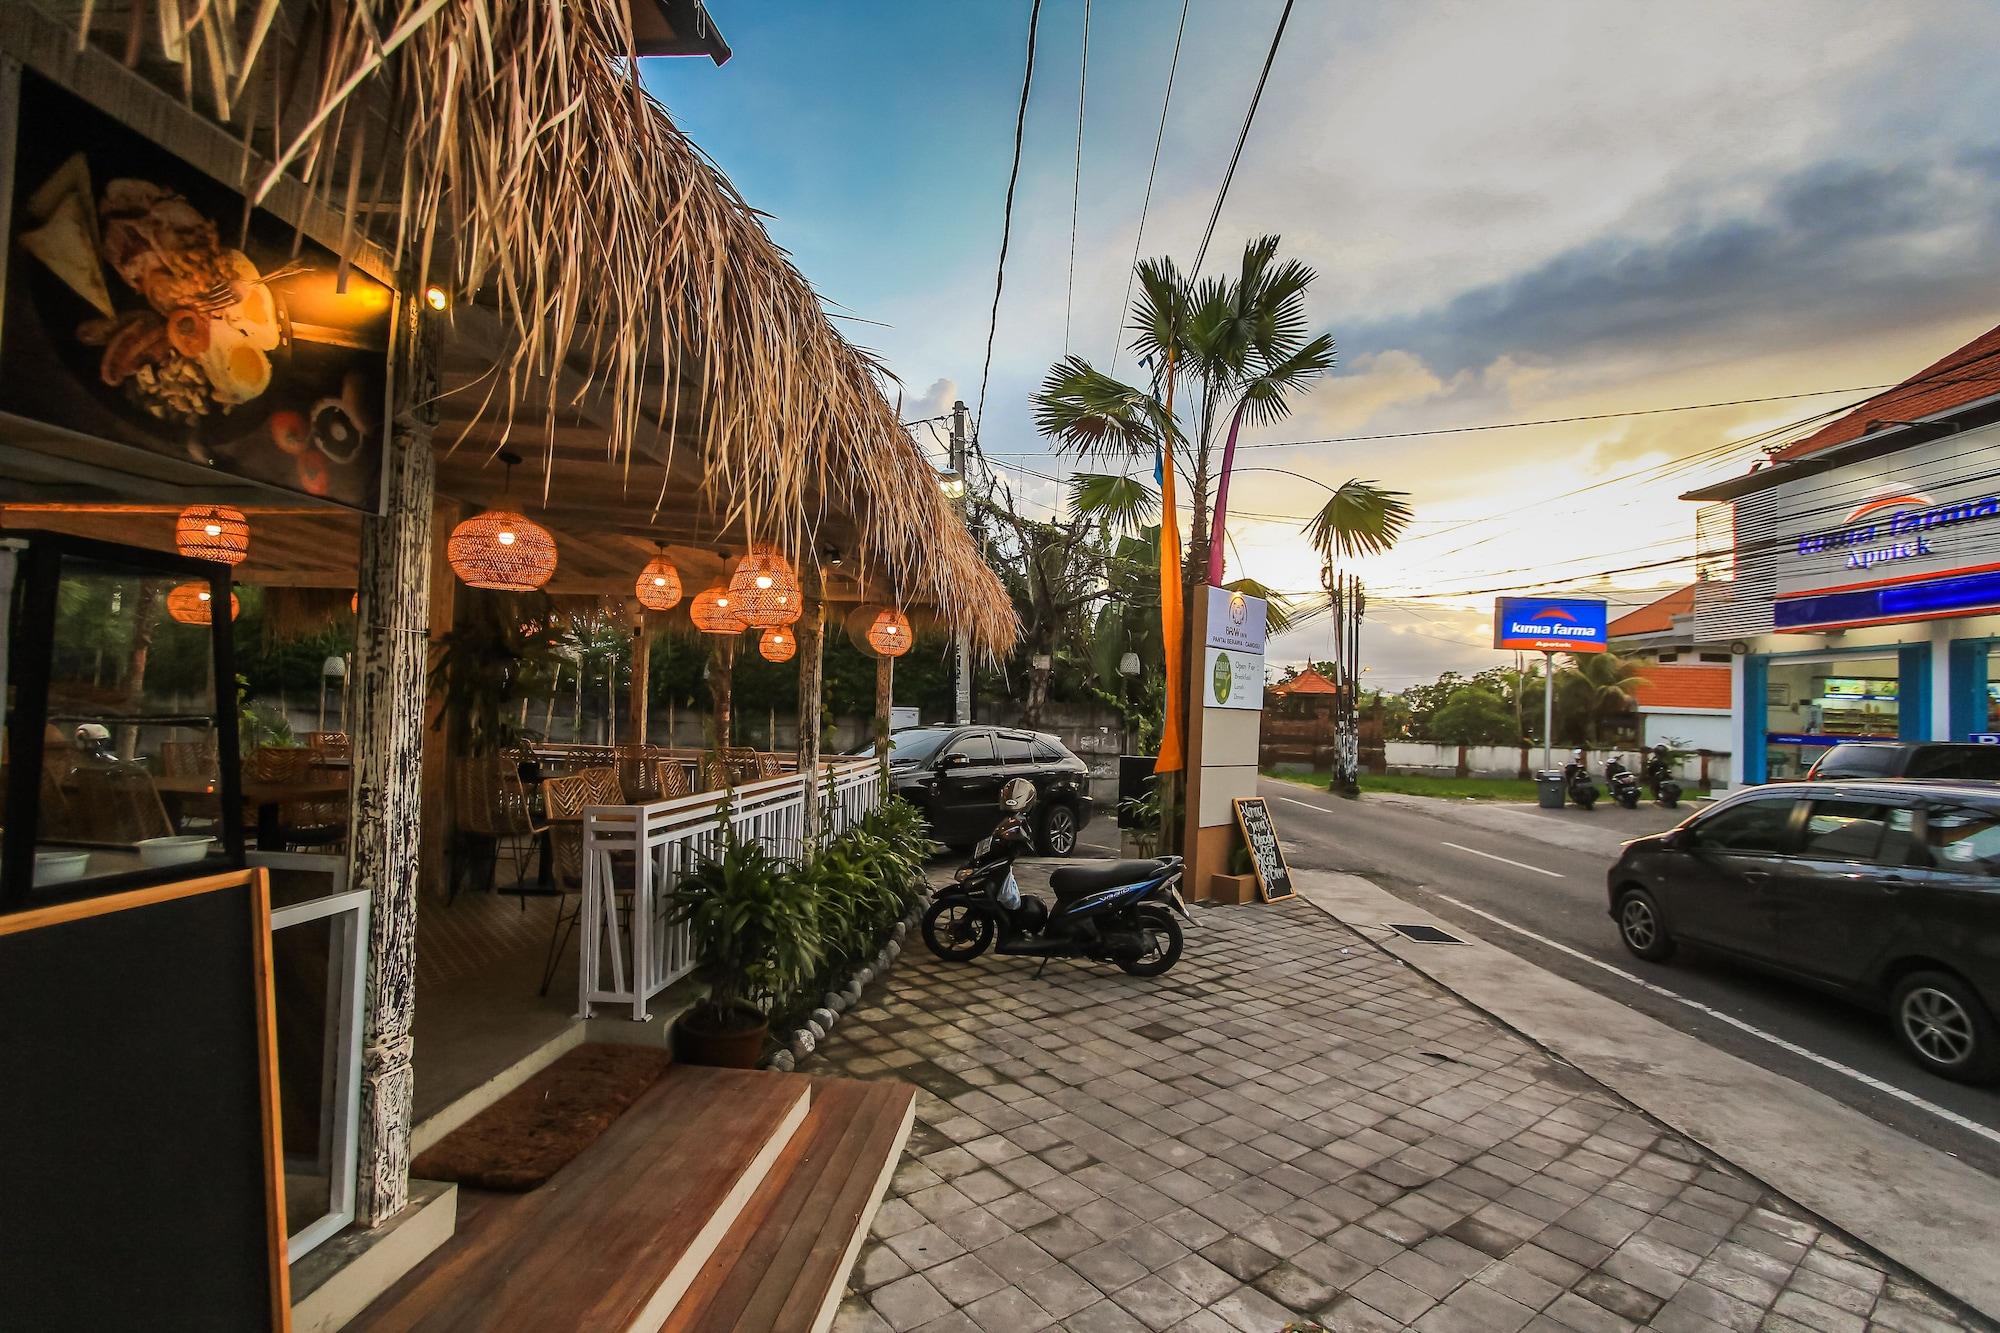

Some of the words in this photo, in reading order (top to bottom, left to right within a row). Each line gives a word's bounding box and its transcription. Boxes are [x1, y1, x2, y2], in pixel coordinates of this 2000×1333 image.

[1512, 623, 1551, 634] kimia
[1553, 624, 1596, 636] farma
[1235, 661, 1247, 671] Open
